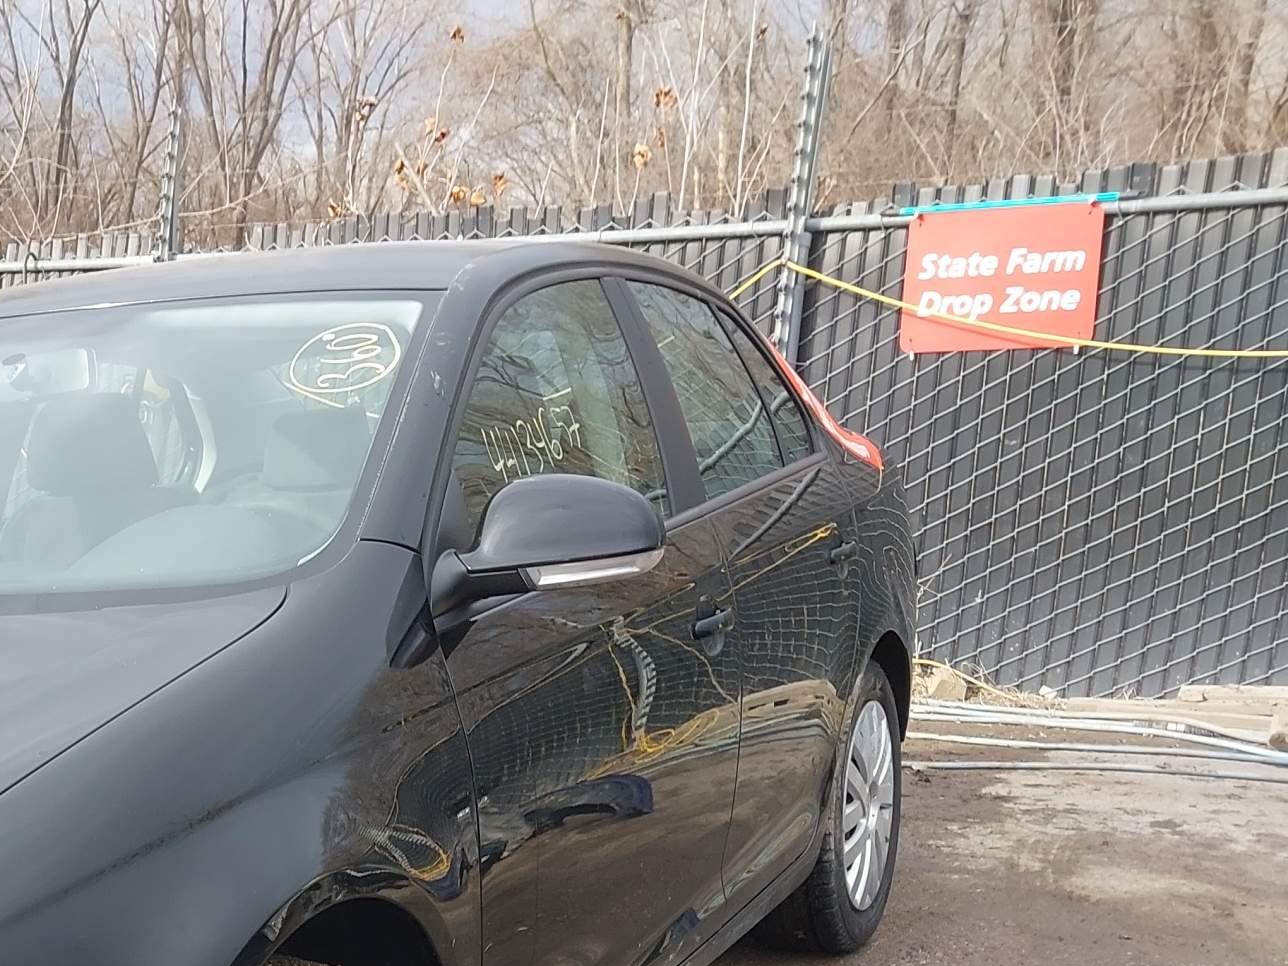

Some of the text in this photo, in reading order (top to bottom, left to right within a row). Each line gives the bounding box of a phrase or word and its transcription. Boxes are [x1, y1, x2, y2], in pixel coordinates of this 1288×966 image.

[918, 248, 1086, 280] State Farm
[916, 286, 1081, 320] Drop Zone
[480, 405, 581, 484] 44134657
